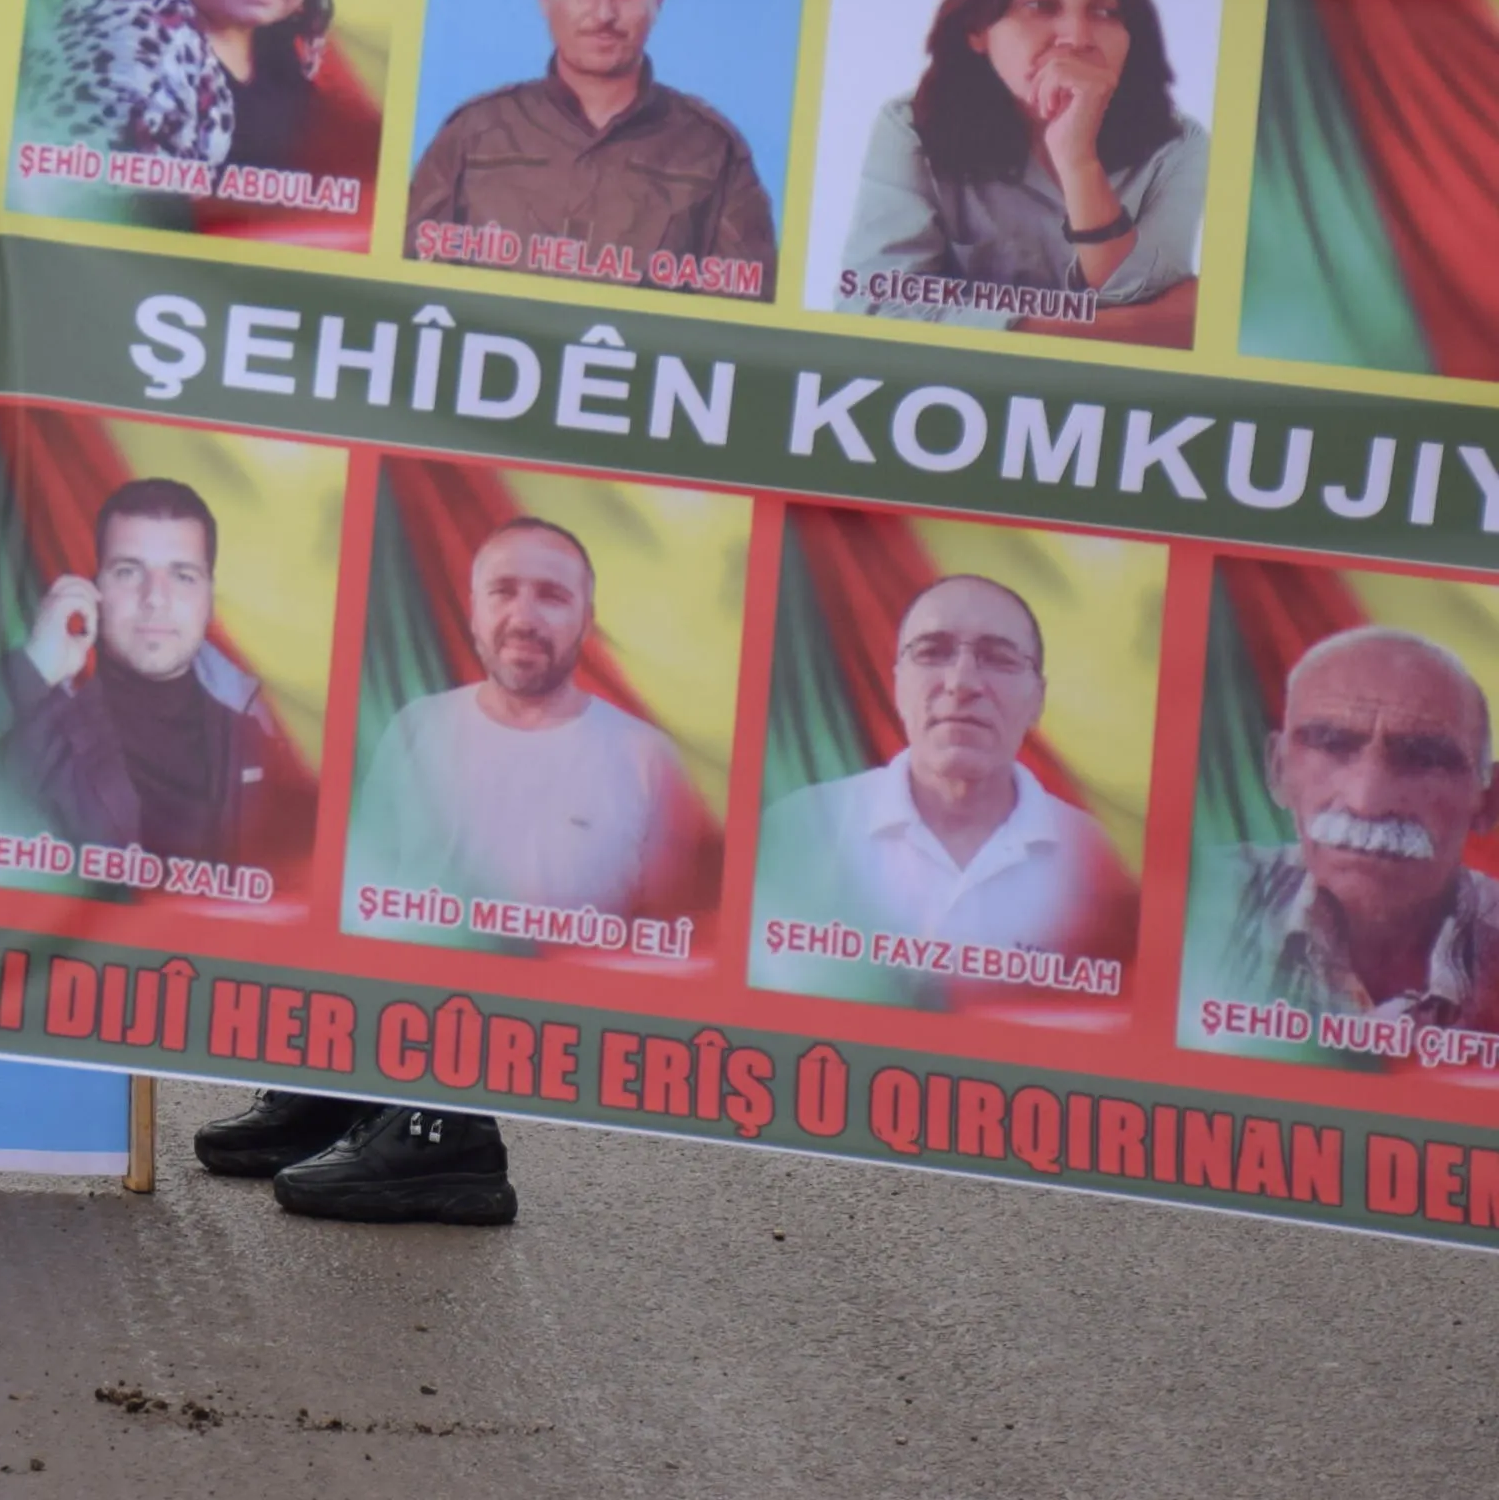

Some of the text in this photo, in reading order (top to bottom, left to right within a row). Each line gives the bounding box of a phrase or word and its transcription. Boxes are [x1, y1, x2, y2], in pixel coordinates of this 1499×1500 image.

[108, 151, 212, 196] HEDIYA
[217, 164, 360, 213] ABDULAH
[528, 233, 643, 283] HELAL
[649, 249, 764, 297] QASIM
[129, 295, 735, 446] ŞEHÎDÊN
[165, 857, 274, 903] XALID
[358, 883, 694, 959] ŞEHÎD MEHMÛD ELÎ
[766, 918, 1122, 996] ŞEHÎD FAYZ EBDULAH
[1201, 998, 1311, 1042] ŞEHÎD
[44, 953, 201, 1053] DIJÎ
[207, 976, 359, 1075] HER
[374, 993, 582, 1104] CÛRE
[599, 1027, 777, 1140] ERÎŞ
[794, 1042, 851, 1140] Û
[866, 1065, 1345, 1209] QIRQIRINAN
